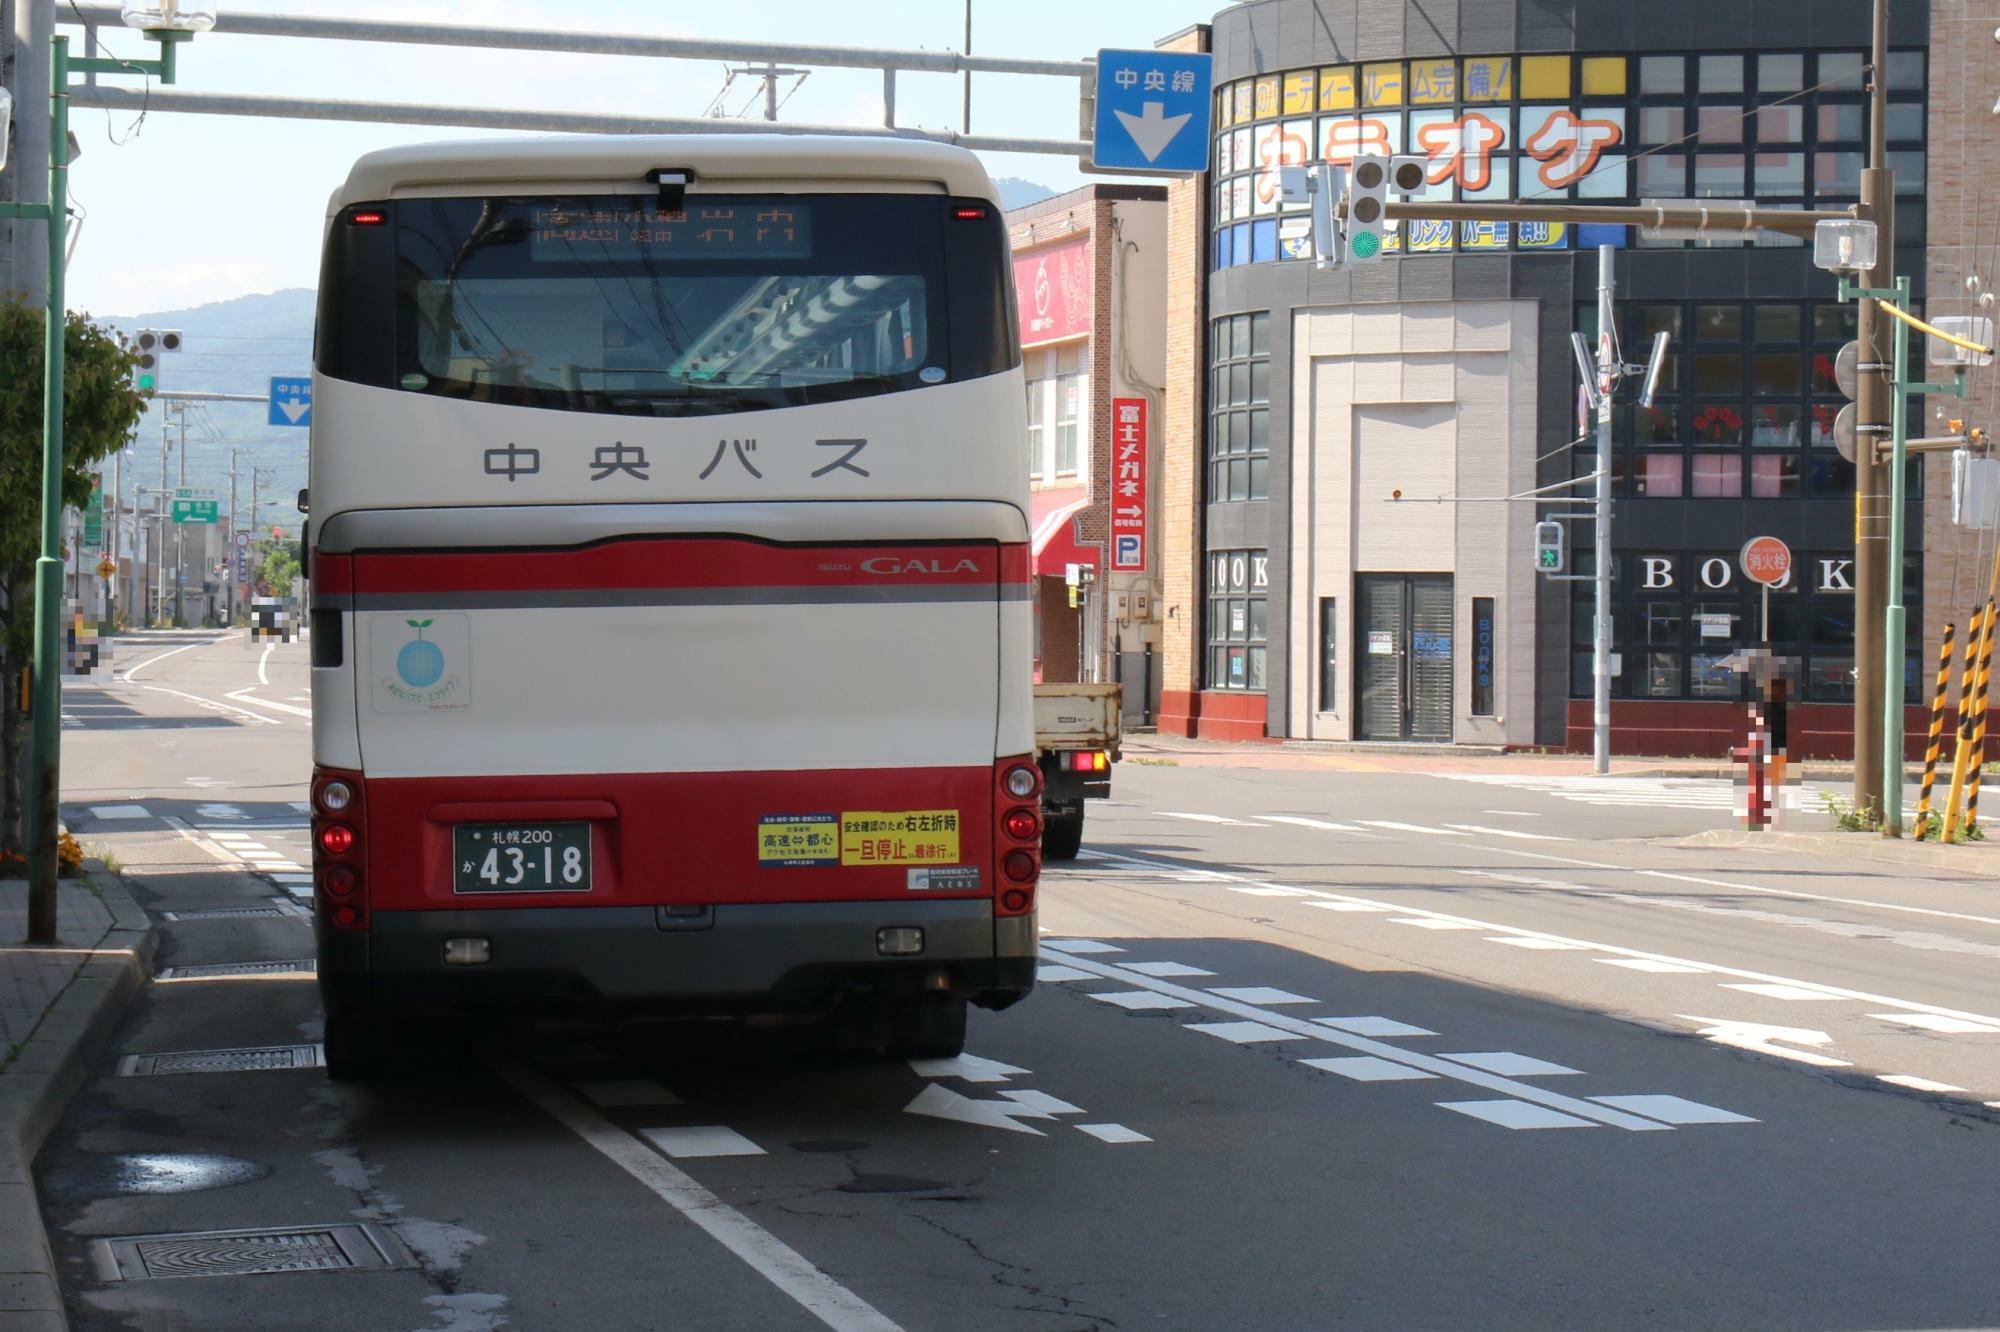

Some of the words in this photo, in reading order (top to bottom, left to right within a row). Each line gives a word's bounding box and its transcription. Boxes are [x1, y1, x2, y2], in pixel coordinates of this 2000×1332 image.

[1114, 67, 1195, 93] 中央線
[1257, 110, 1622, 203] カラオケ
[483, 438, 870, 482] 中央バス
[1118, 405, 1141, 497] 富士メガネ
[1118, 537, 1139, 564] P
[1747, 552, 1788, 570] 消火栓
[860, 557, 980, 574] GALA
[1642, 557, 1853, 590] BOK
[1478, 619, 1490, 688] BOOKS
[844, 815, 956, 832] 安全確認のため右左折時
[764, 834, 790, 847] 高速
[807, 833, 833, 847] 都心
[462, 860, 476, 873] か
[480, 846, 582, 884] 43-18
[938, 880, 973, 888] AEBS
